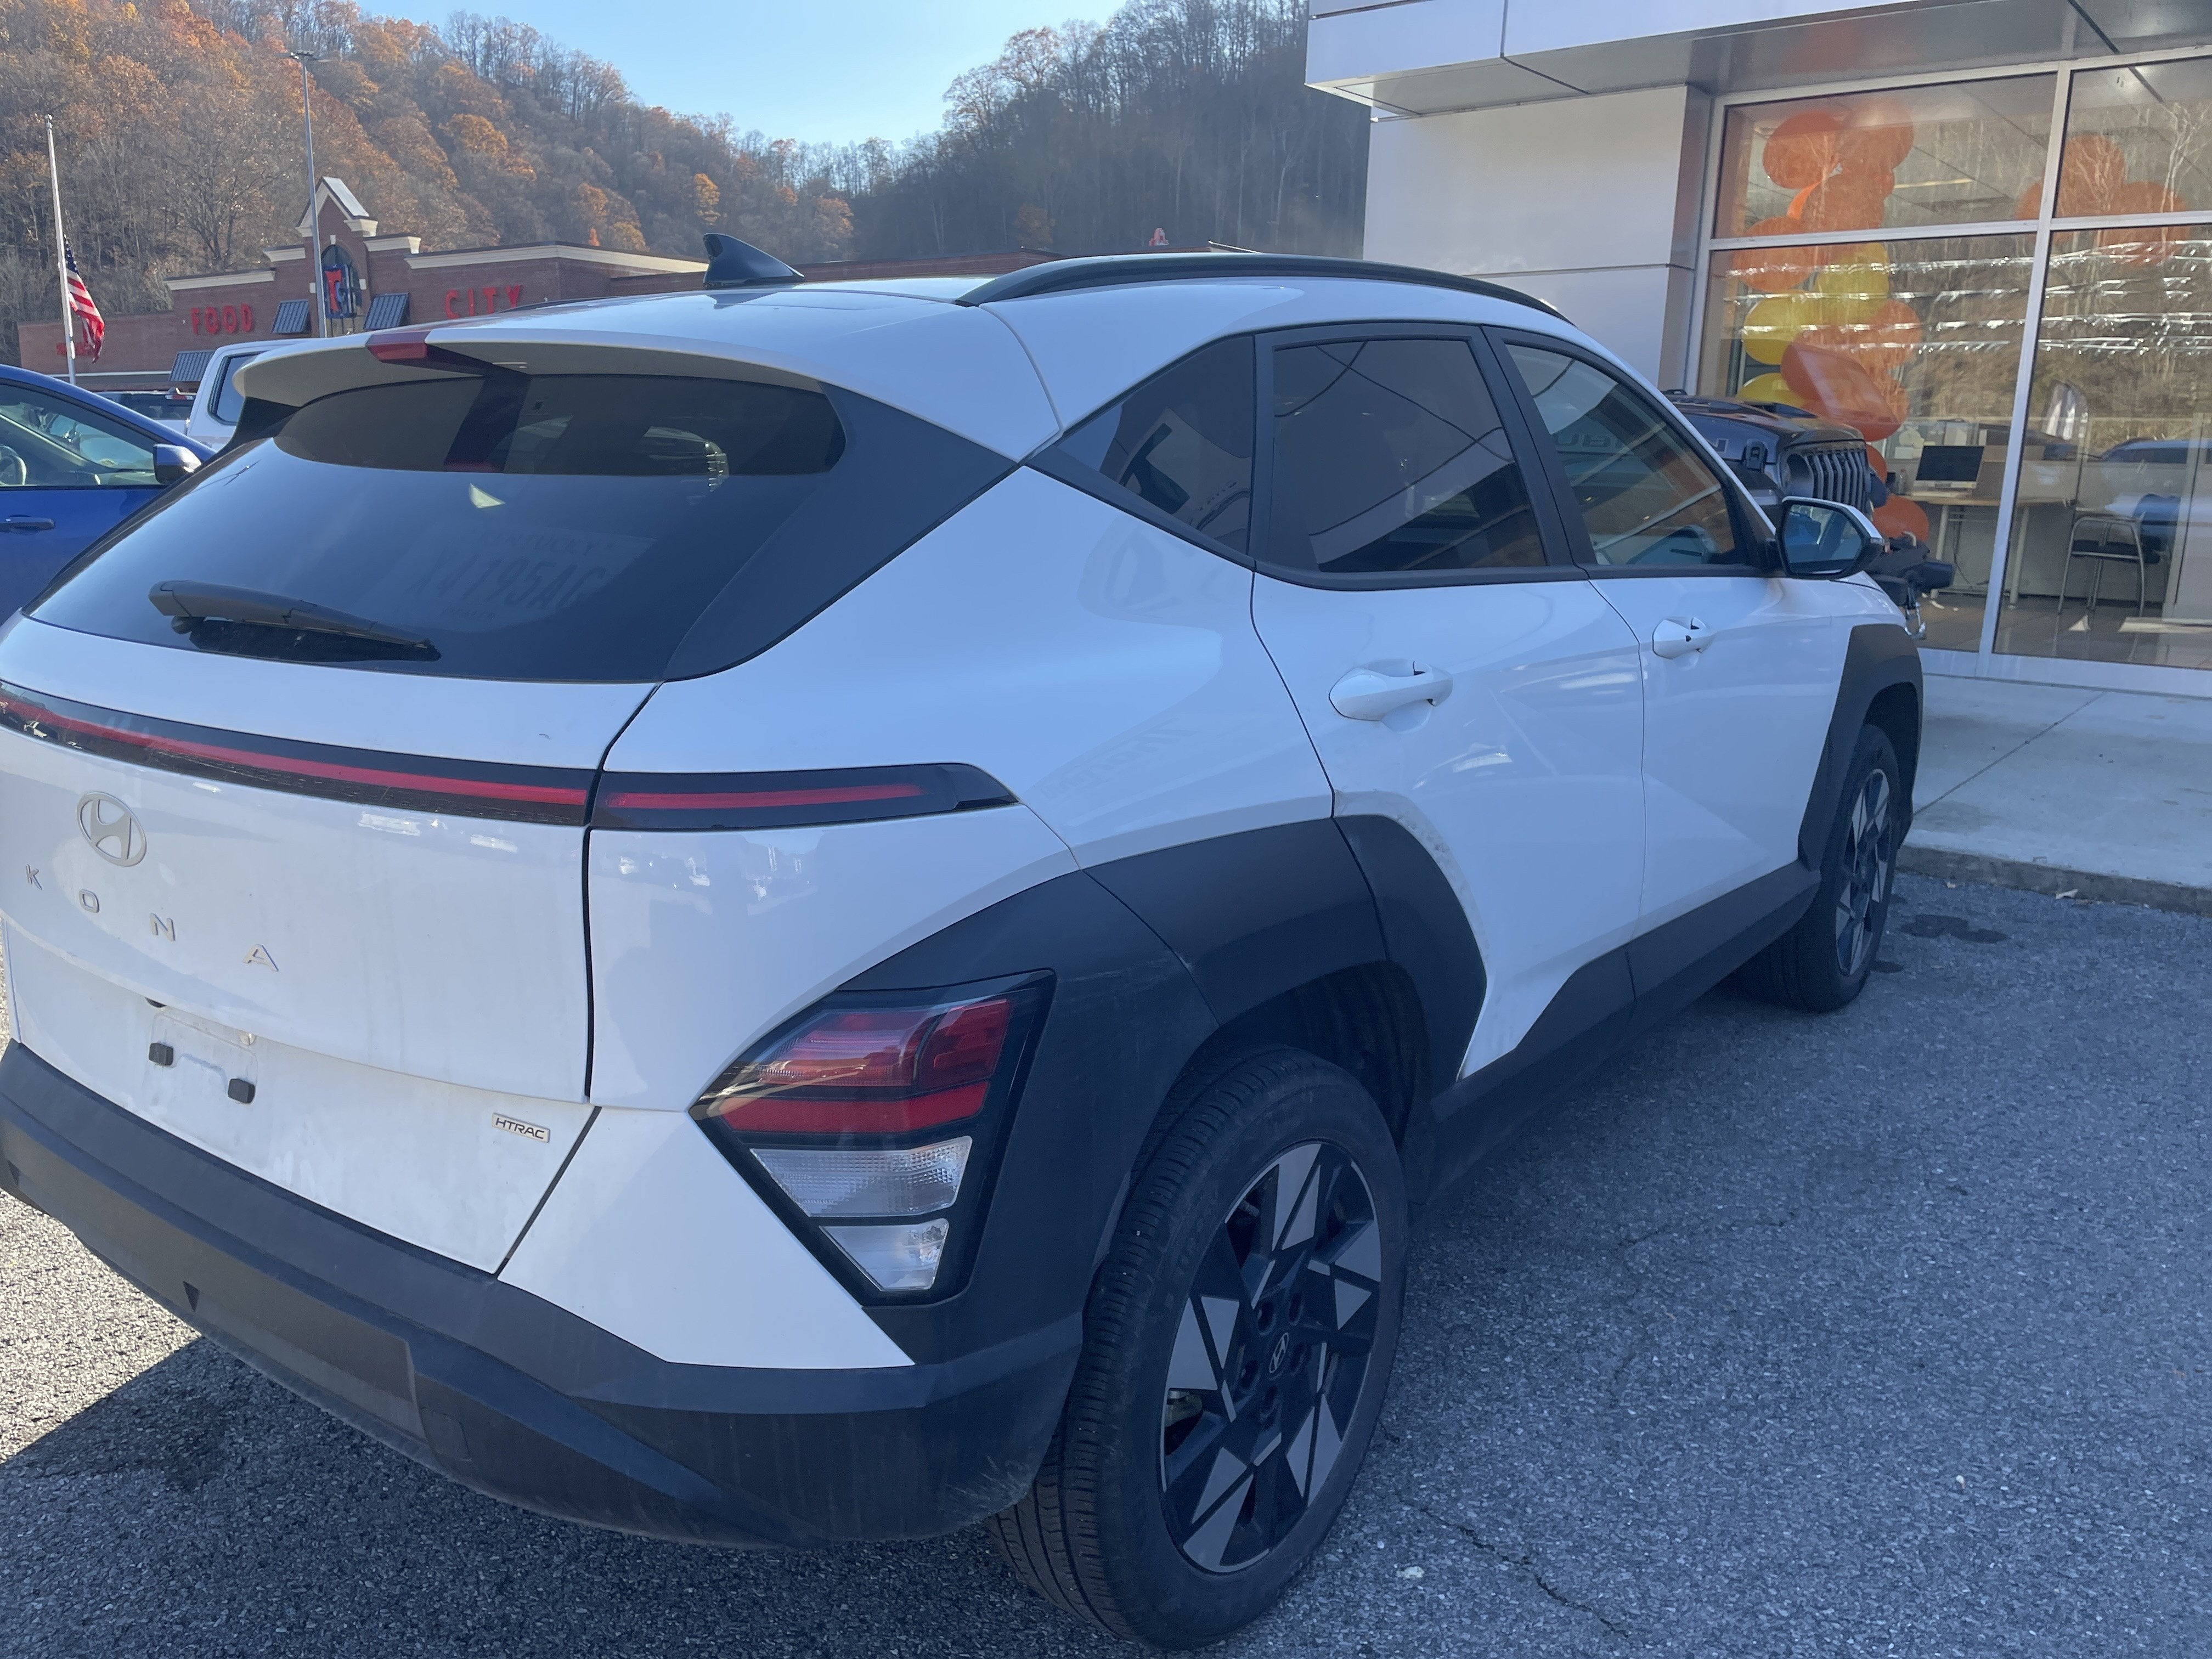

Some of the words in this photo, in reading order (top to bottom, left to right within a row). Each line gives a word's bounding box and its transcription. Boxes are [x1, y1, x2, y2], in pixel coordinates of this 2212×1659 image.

[190, 303, 252, 334] FOOD
[445, 285, 521, 319] CITY
[25, 864, 279, 972] KONA
[495, 1117, 545, 1139] HTRAC
